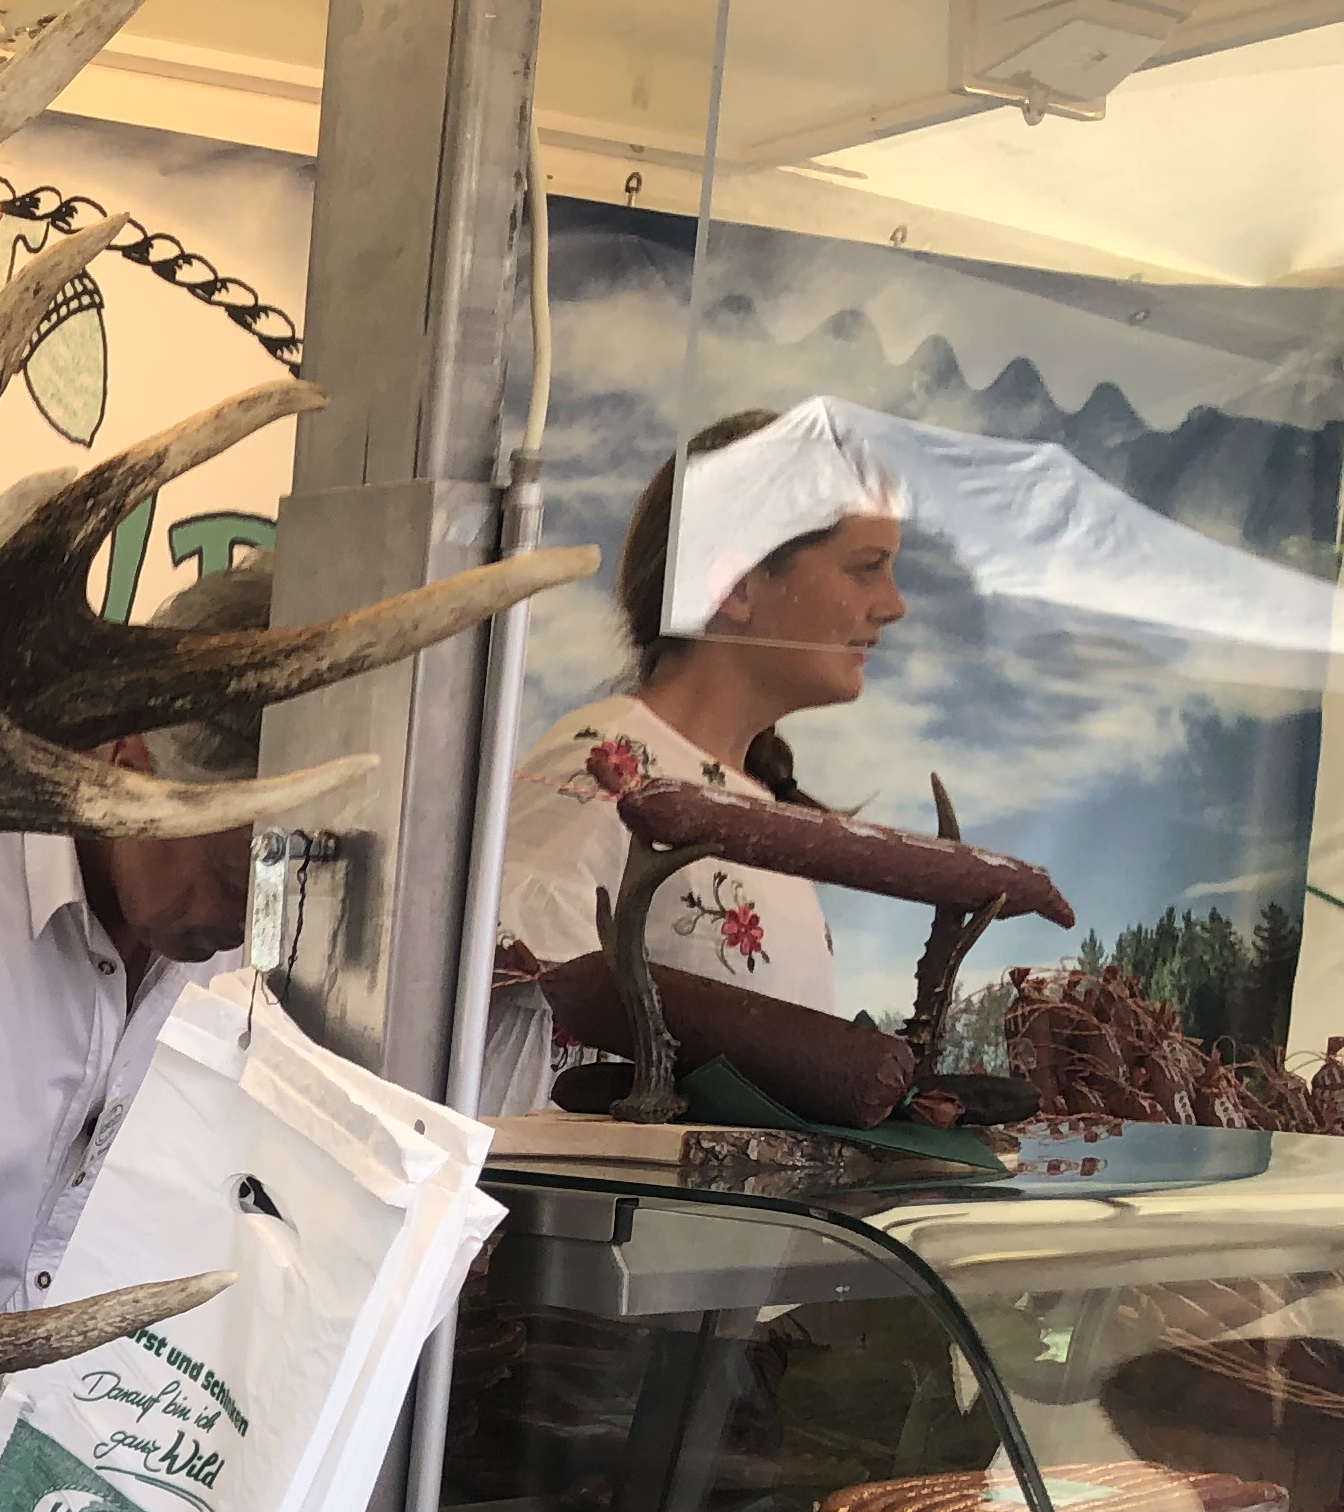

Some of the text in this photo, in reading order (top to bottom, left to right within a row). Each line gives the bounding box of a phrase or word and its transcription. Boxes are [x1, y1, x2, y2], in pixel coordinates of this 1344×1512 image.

[166, 1347, 205, 1382] und
[73, 1371, 181, 1424] Darauf
[162, 1390, 190, 1423] bin
[194, 1406, 222, 1433] ich
[93, 1429, 225, 1490] ganz Wild
